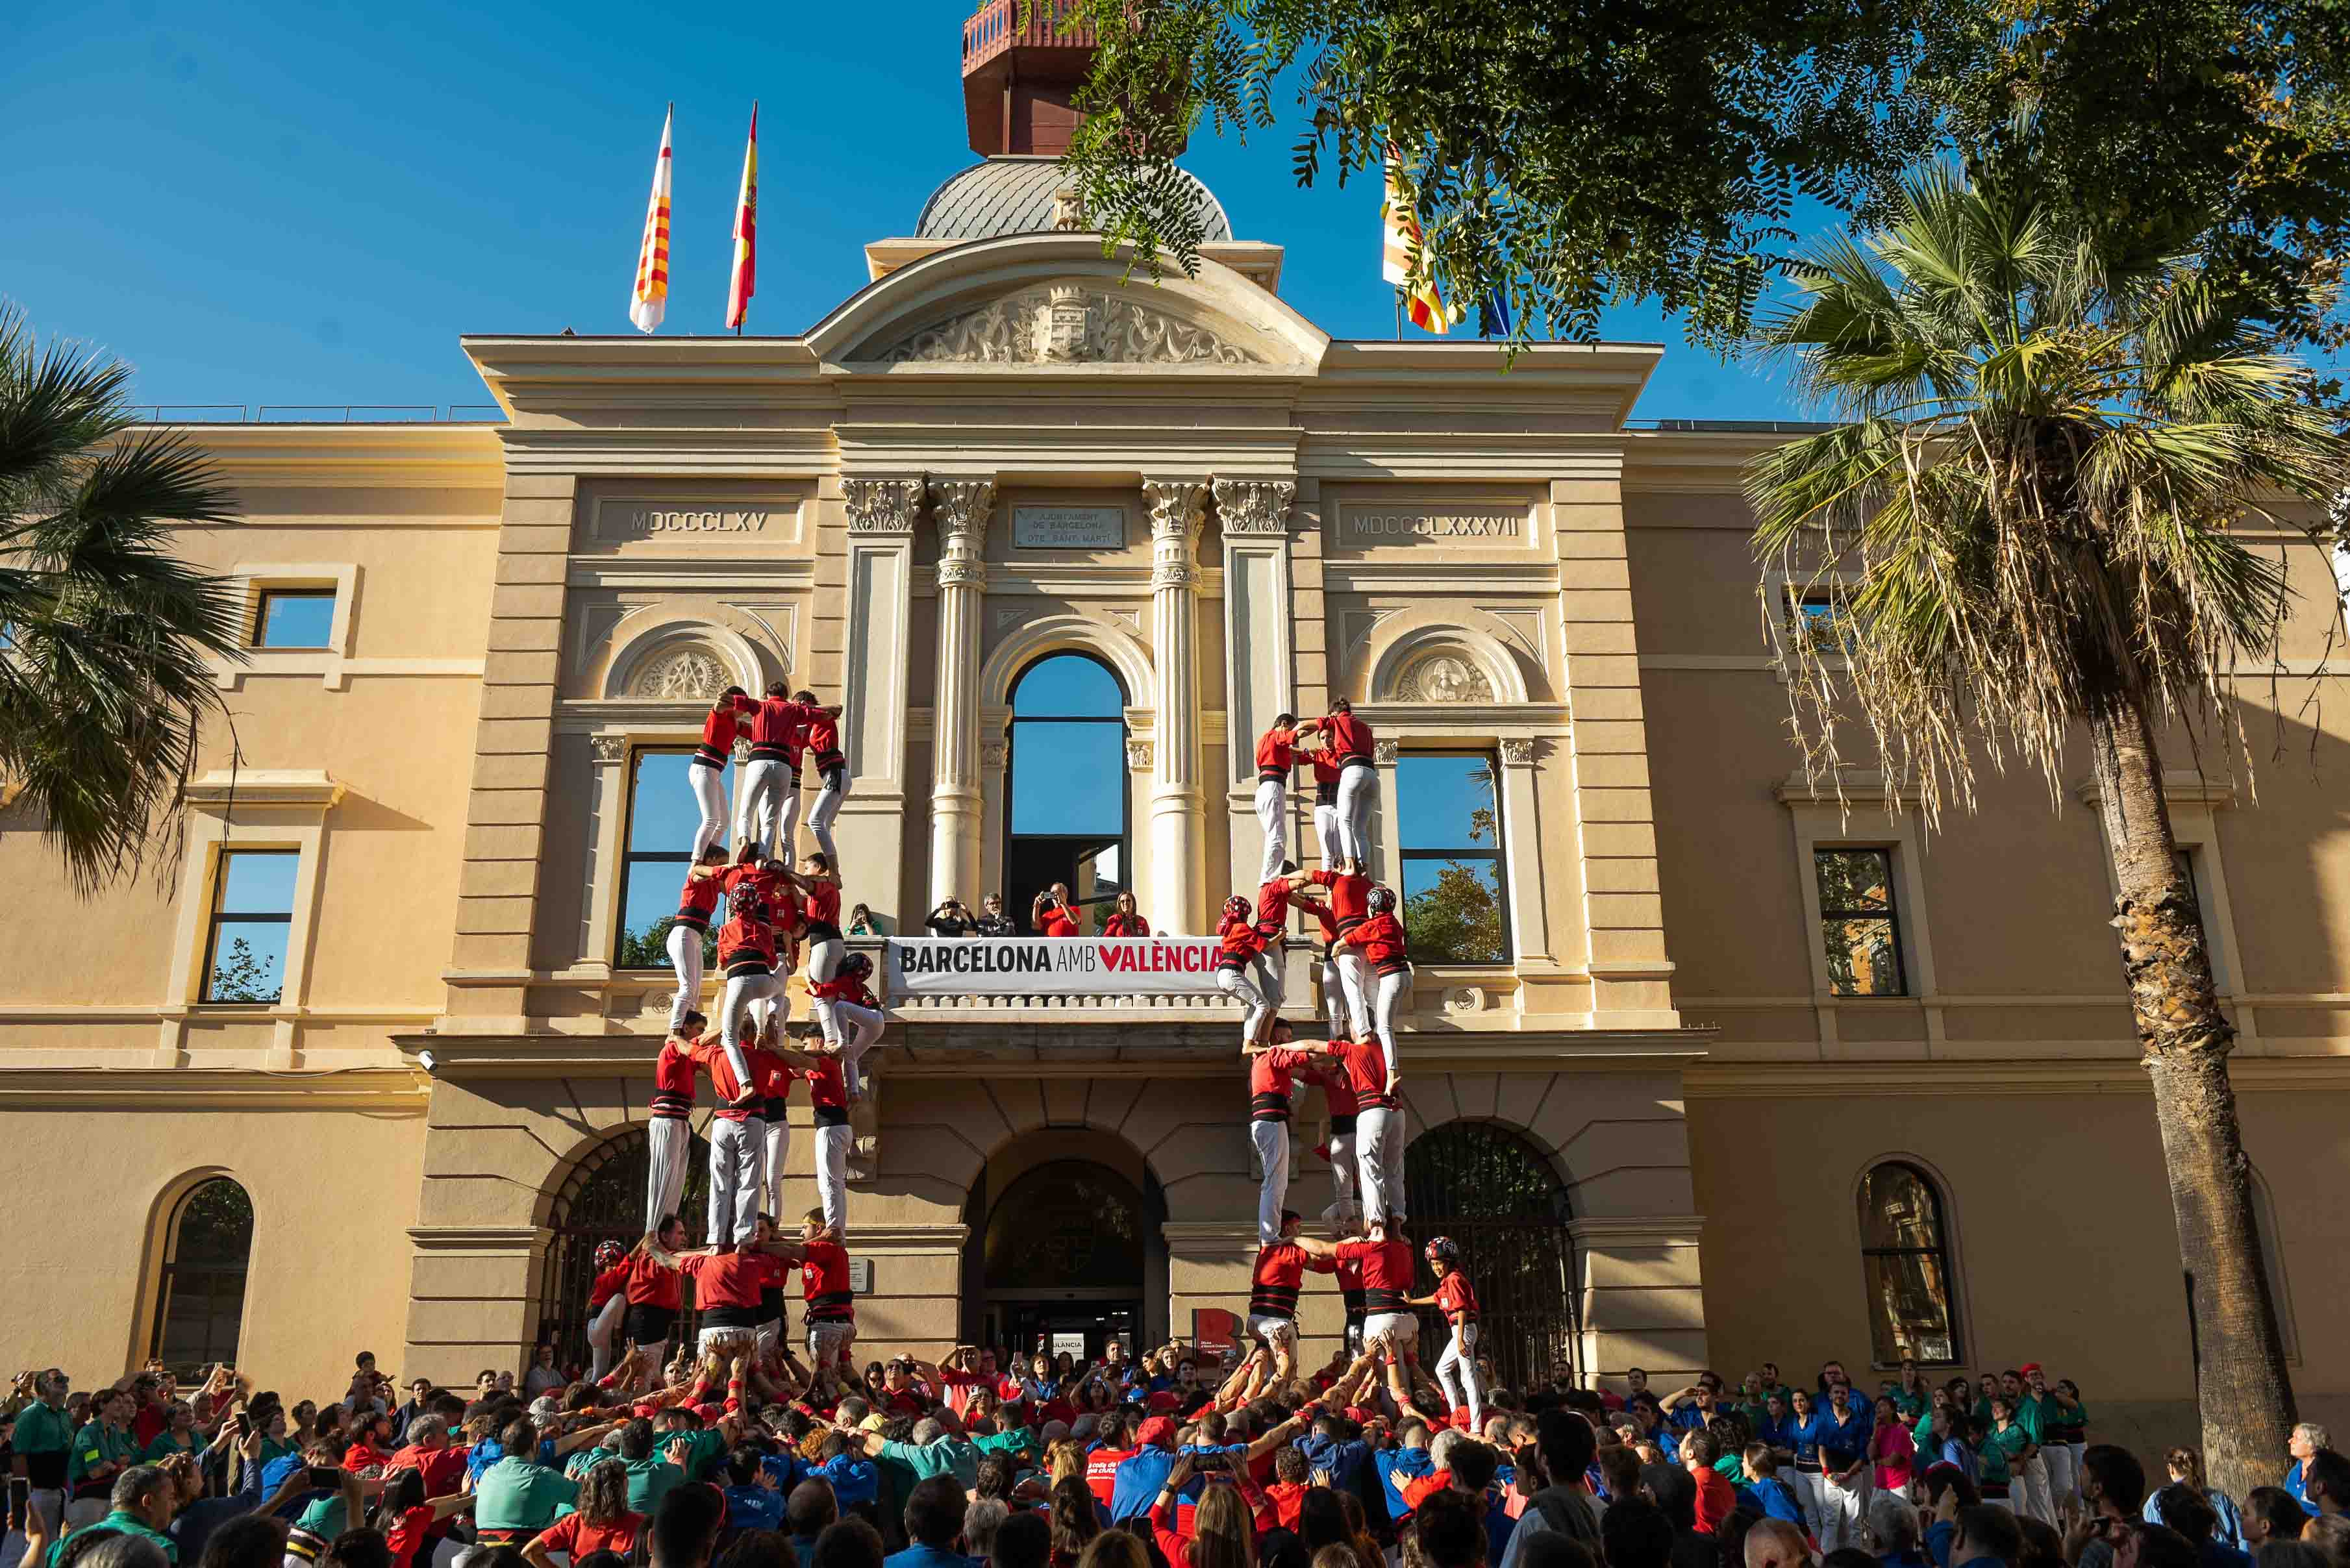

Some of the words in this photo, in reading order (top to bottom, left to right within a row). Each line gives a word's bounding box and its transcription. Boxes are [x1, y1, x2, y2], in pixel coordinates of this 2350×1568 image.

[632, 512, 768, 532] MDCCCLXV
[1354, 516, 1518, 536] MDCCCLXXXVII
[901, 945, 1053, 973] BARCELONA
[1056, 945, 1096, 972] AMB
[1098, 940, 1223, 972] VALÈNCIA
